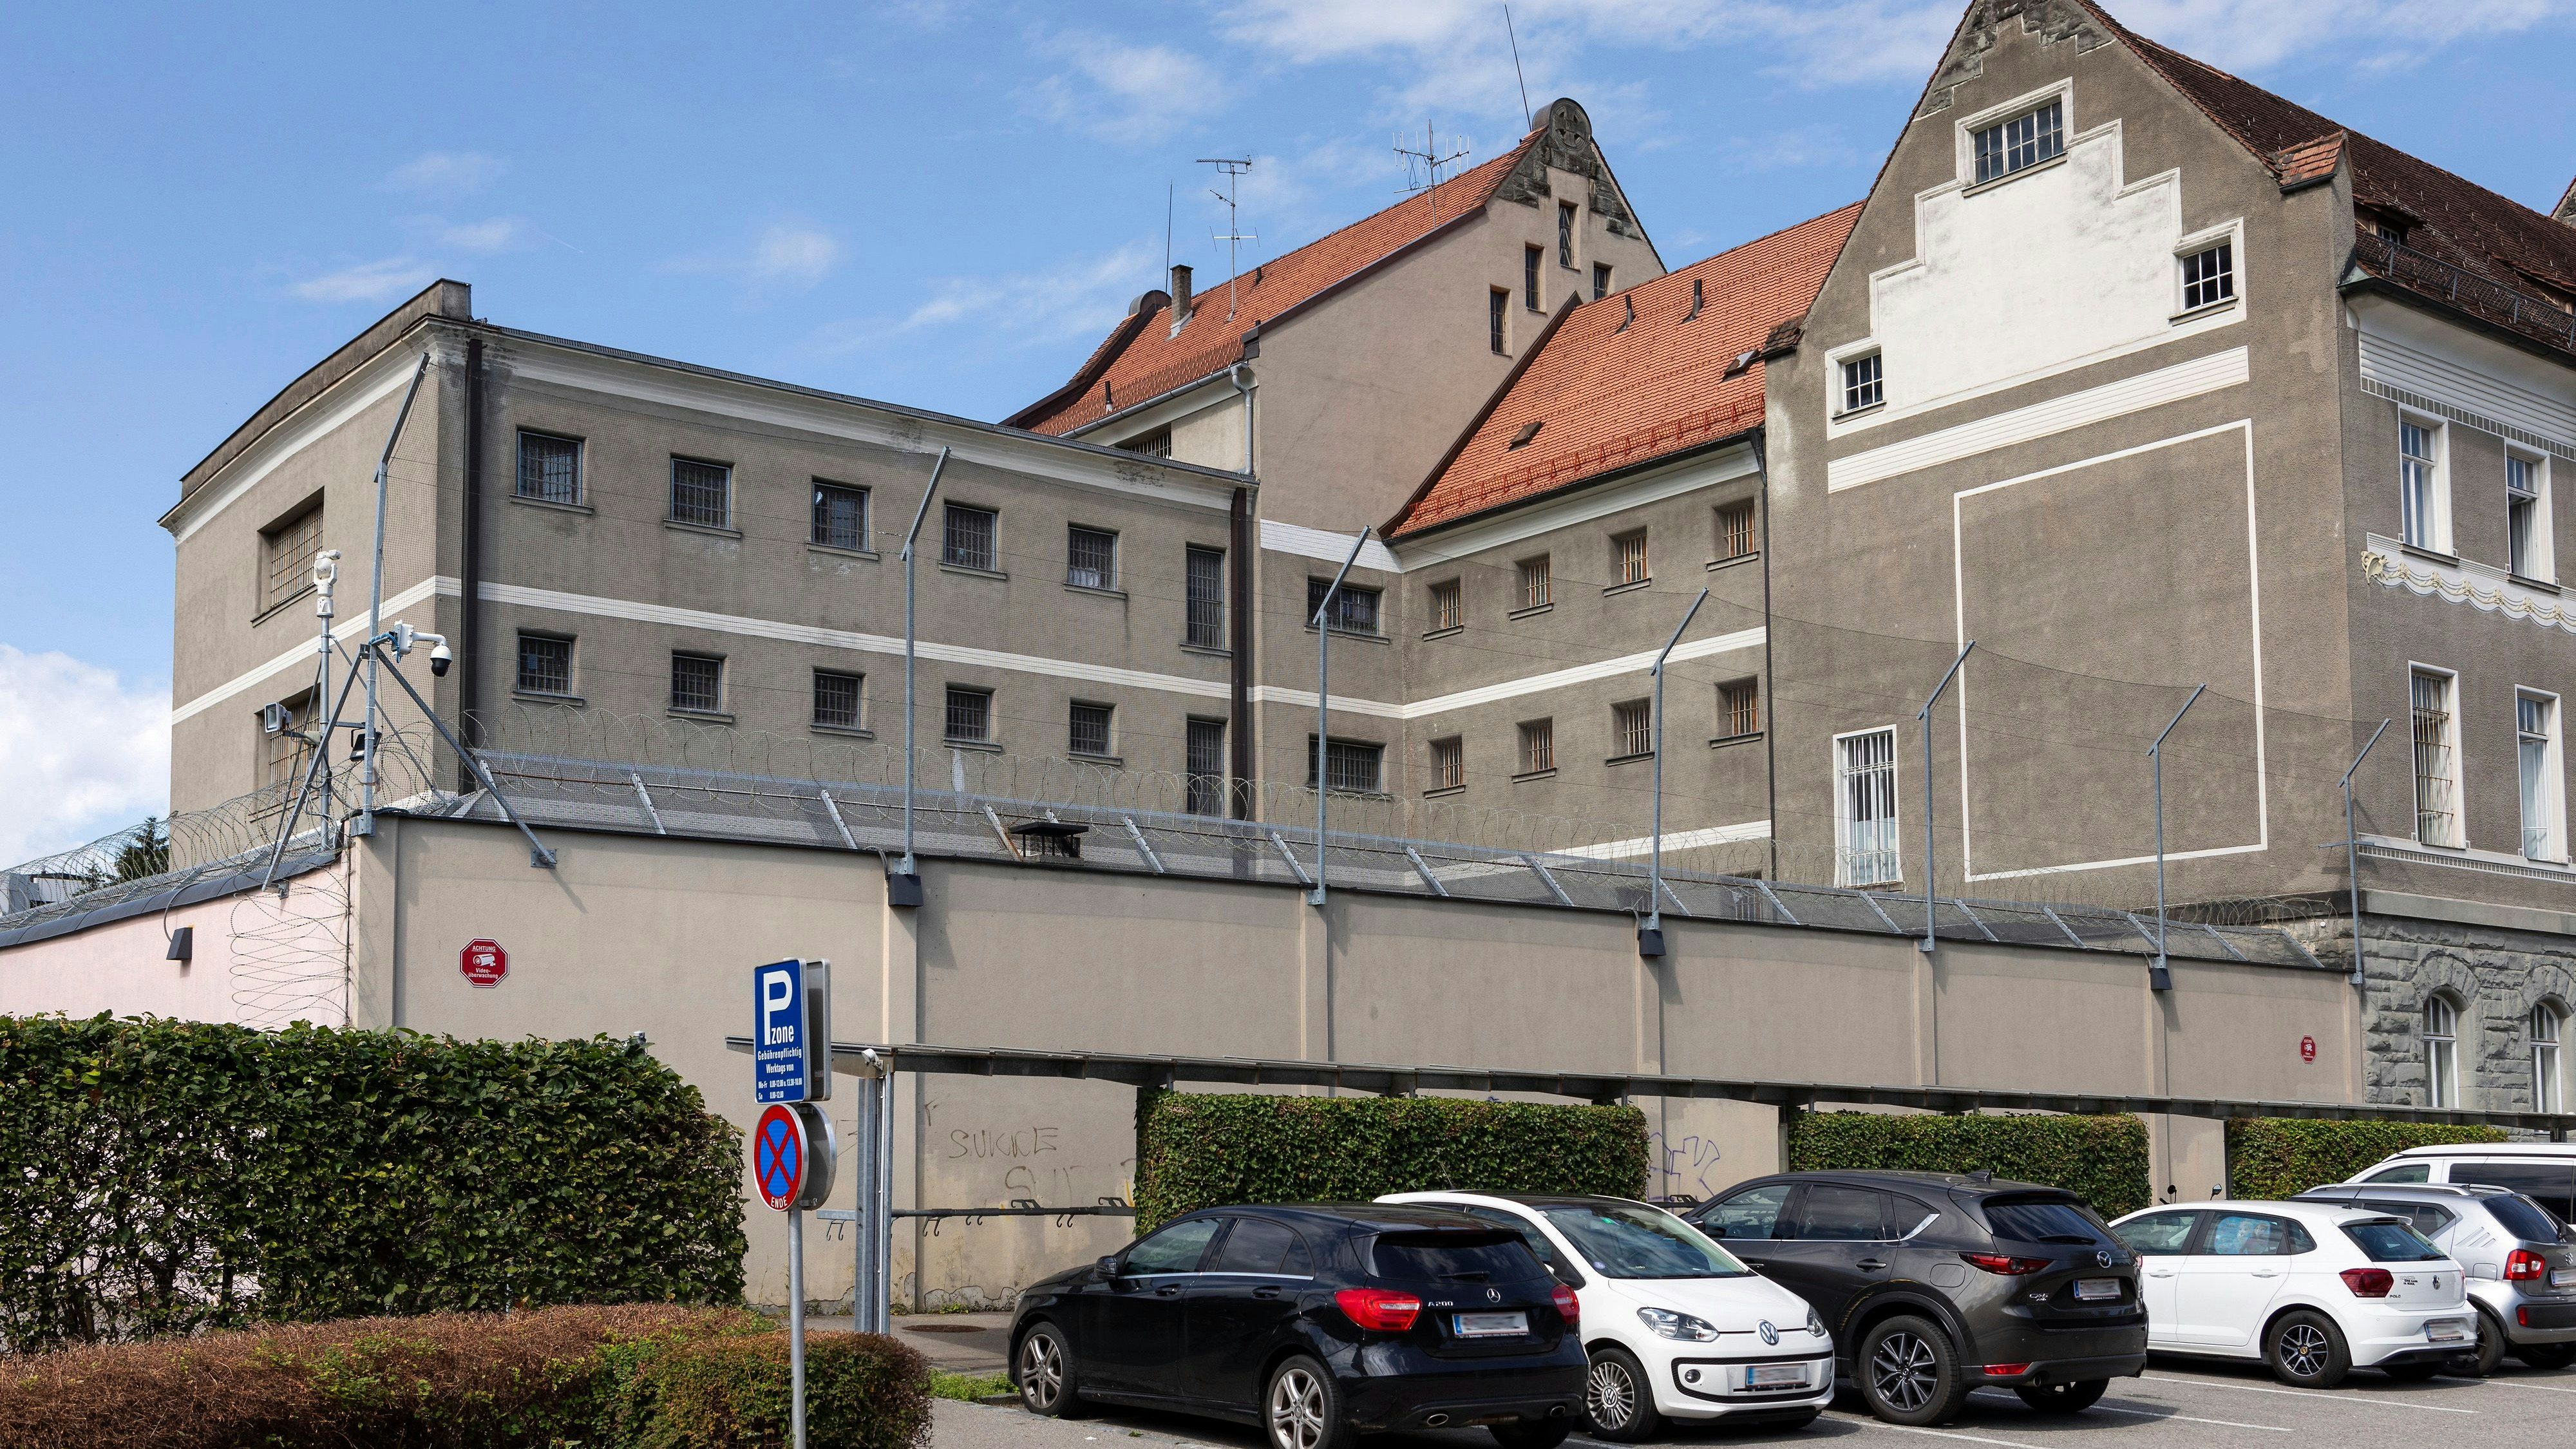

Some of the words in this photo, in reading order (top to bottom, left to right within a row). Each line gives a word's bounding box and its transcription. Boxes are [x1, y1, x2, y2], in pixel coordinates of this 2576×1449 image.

[763, 970, 793, 1045] P
[771, 1025, 794, 1045] zone
[757, 1046, 802, 1061] Gebührenpflichtig
[766, 1063, 786, 1074] Werktags
[771, 1196, 787, 1208] ENDE
